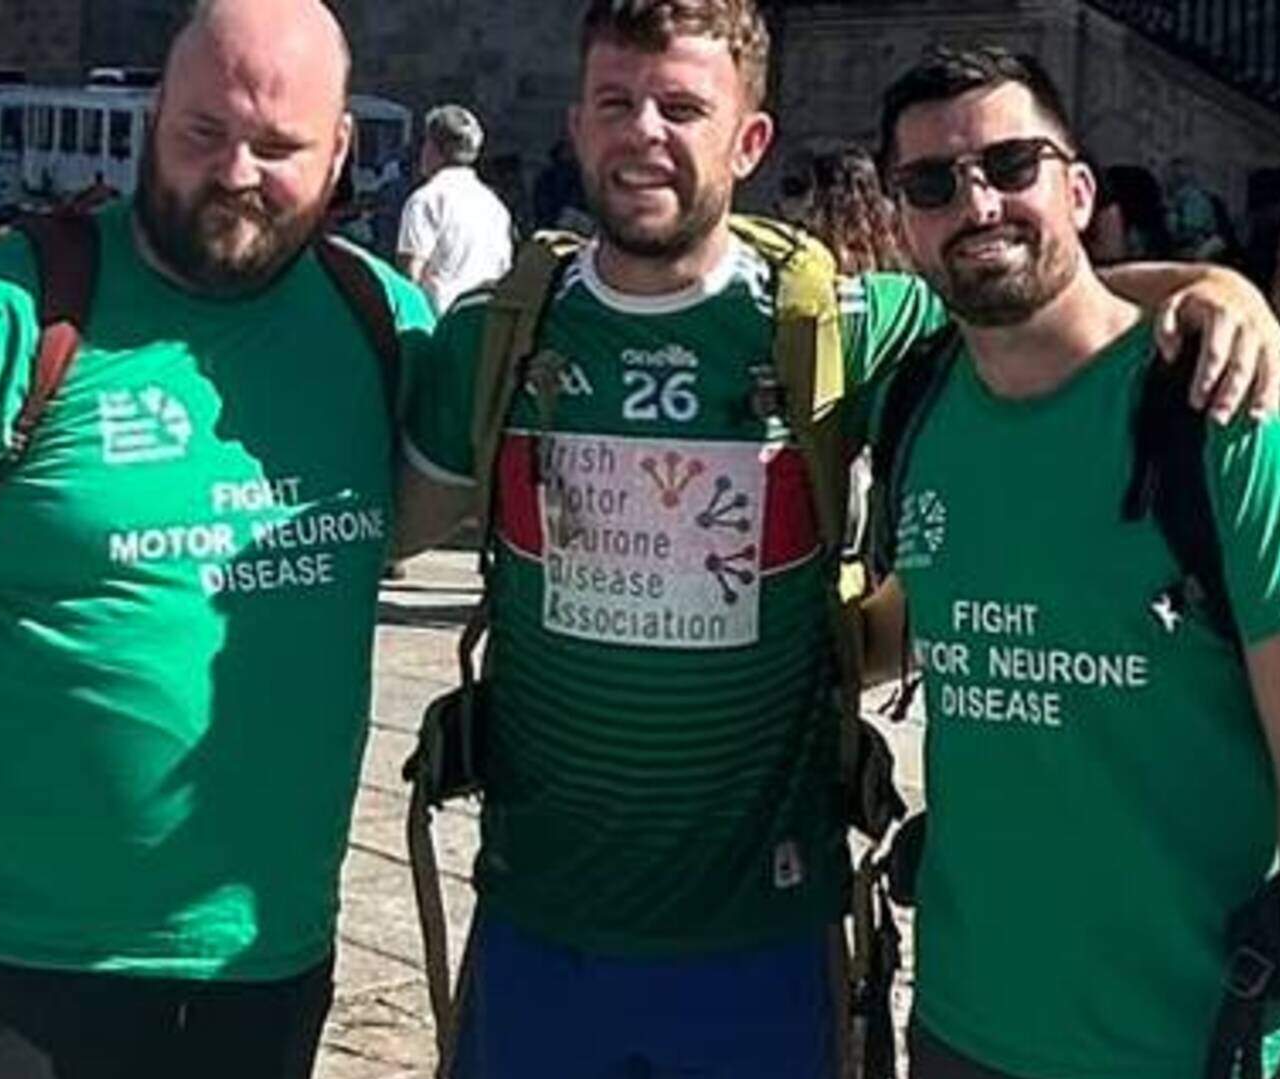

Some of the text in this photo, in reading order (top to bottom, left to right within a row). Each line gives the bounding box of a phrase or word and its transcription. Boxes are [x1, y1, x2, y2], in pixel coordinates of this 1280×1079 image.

[622, 370, 700, 421] 26
[213, 478, 301, 513] FIGHT
[550, 478, 628, 514] otor
[109, 508, 384, 563] MOTOR NEURONE
[554, 526, 671, 559] eurone
[203, 554, 334, 593] DISEASE
[548, 553, 665, 599] Disease
[548, 591, 726, 641] Association
[952, 600, 1039, 635] FIGHT
[988, 646, 1150, 687] NEURONE
[941, 685, 1063, 726] DISEASE
